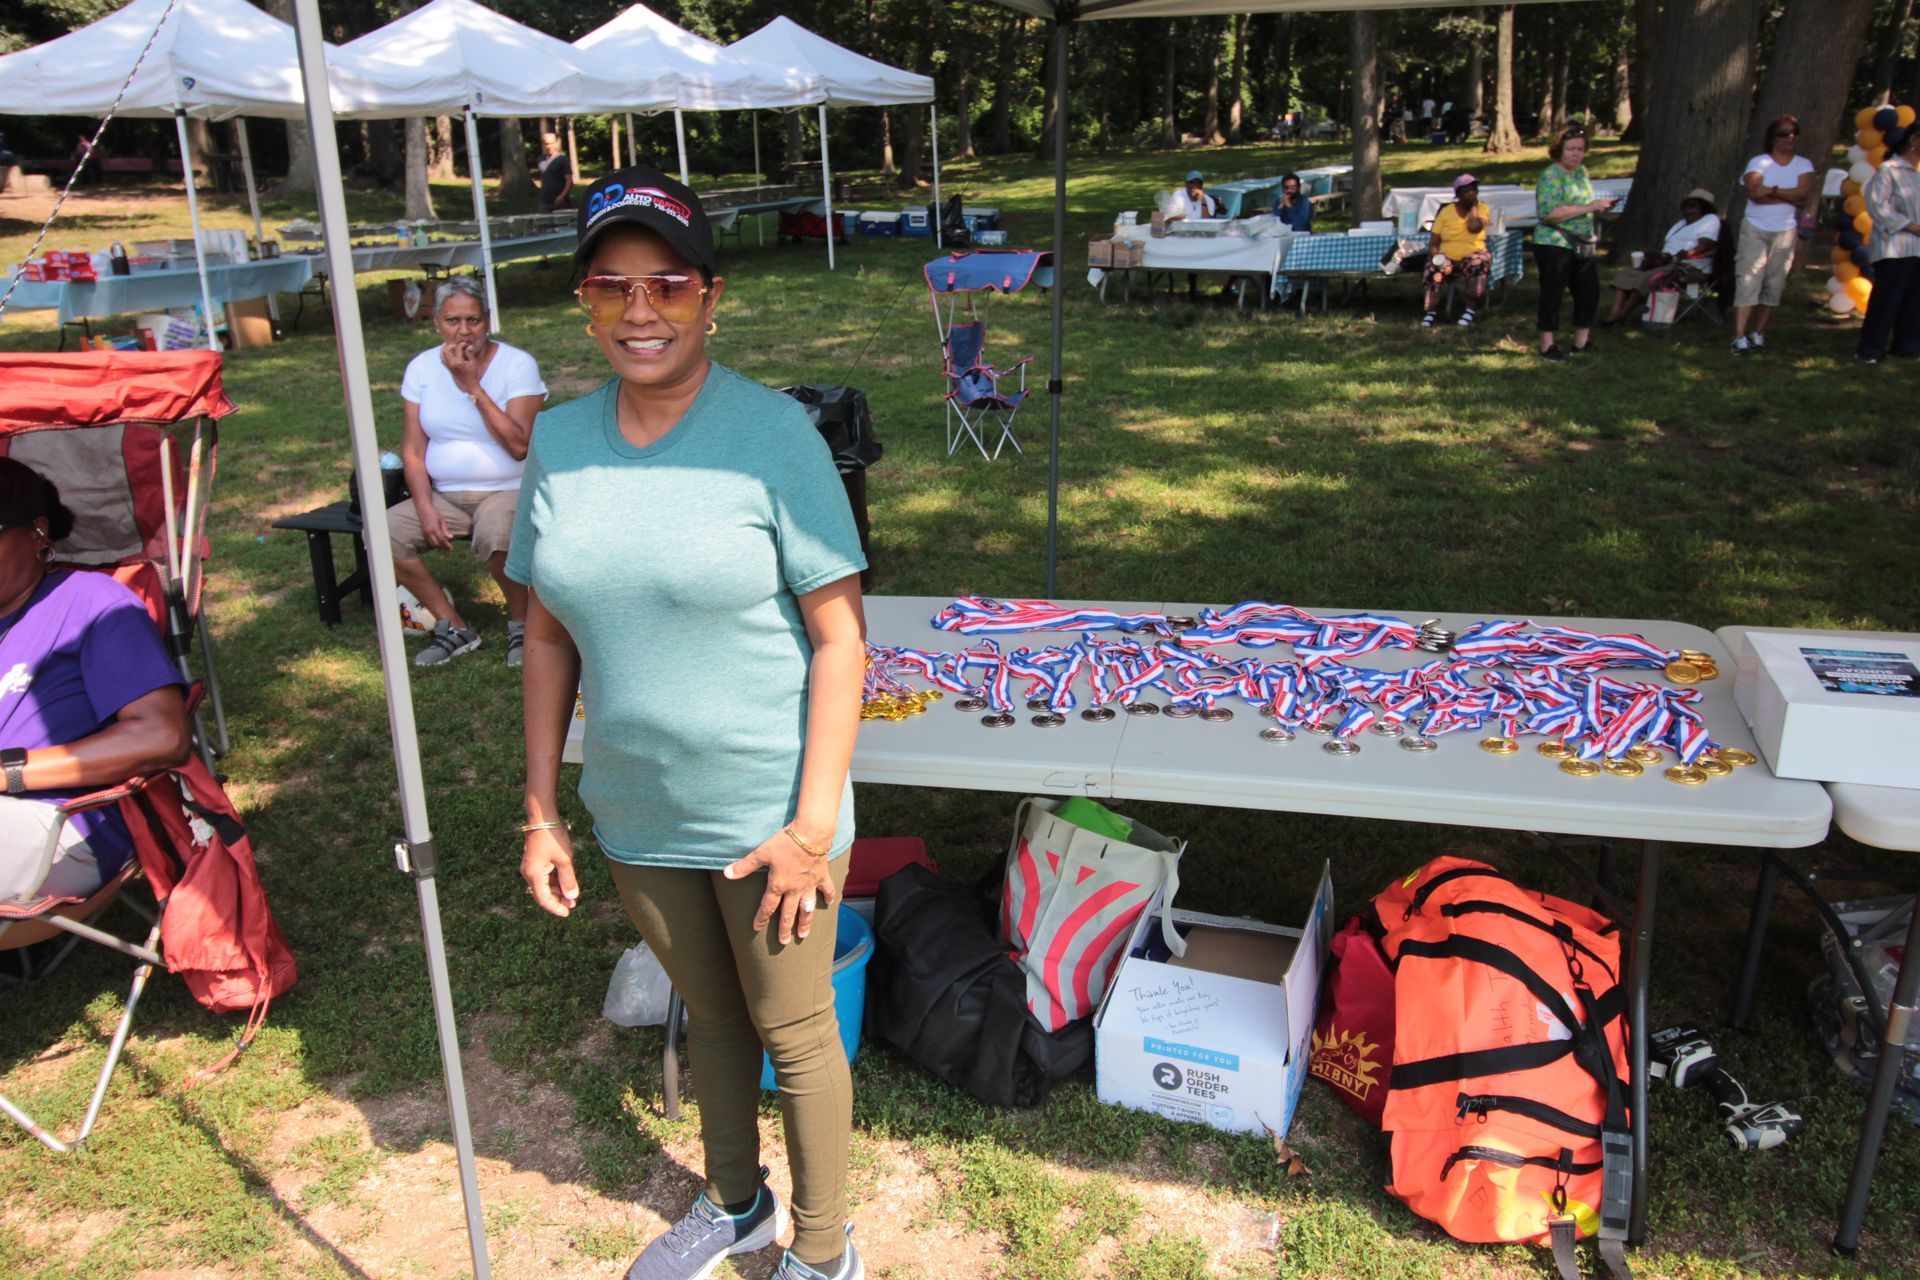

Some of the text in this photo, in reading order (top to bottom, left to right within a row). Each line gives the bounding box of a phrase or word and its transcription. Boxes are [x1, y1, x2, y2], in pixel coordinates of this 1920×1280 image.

[622, 193, 652, 205] AUTO
[653, 198, 685, 216] PARTS
[1836, 667, 1894, 675] SUNDAY
[1172, 976, 1195, 996] You!
[1151, 1043, 1232, 1065] PRINTED FOR YOU
[1186, 1068, 1220, 1083] RUSH
[1186, 1077, 1229, 1094] ORDER
[1186, 1086, 1216, 1100] TEES
[1151, 1101, 1176, 1110] CUSTOM
